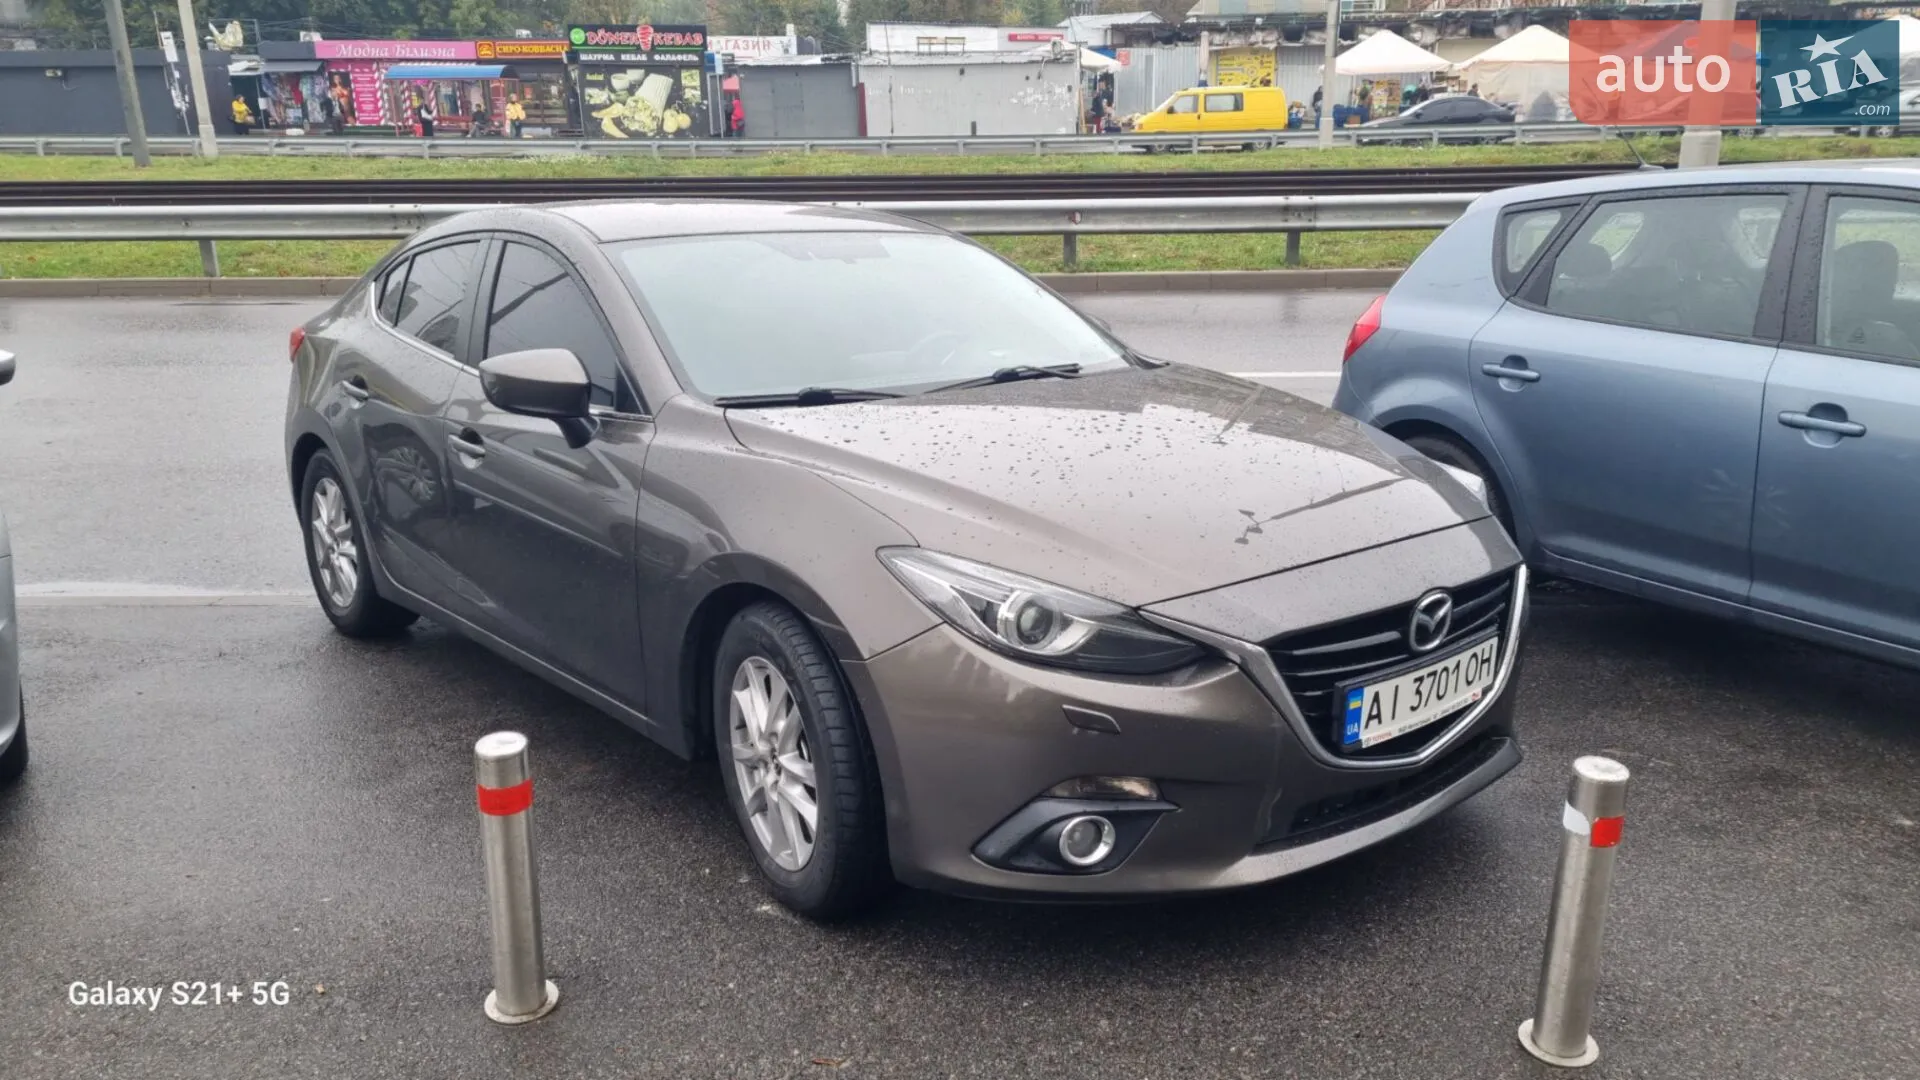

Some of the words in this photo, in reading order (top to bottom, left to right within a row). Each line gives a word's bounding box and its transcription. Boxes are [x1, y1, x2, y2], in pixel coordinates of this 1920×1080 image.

[586, 28, 638, 45] DÖNER
[653, 32, 703, 46] KEBAB
[336, 40, 389, 57] Модна
[393, 43, 456, 58] Білизна
[621, 53, 648, 61] КЕБАБ
[653, 53, 699, 61] ФАЛАФЕЛЬ
[1364, 684, 1399, 729] AI
[1409, 660, 1461, 712] 3701
[1465, 643, 1494, 687] OH
[1346, 722, 1360, 735] UA
